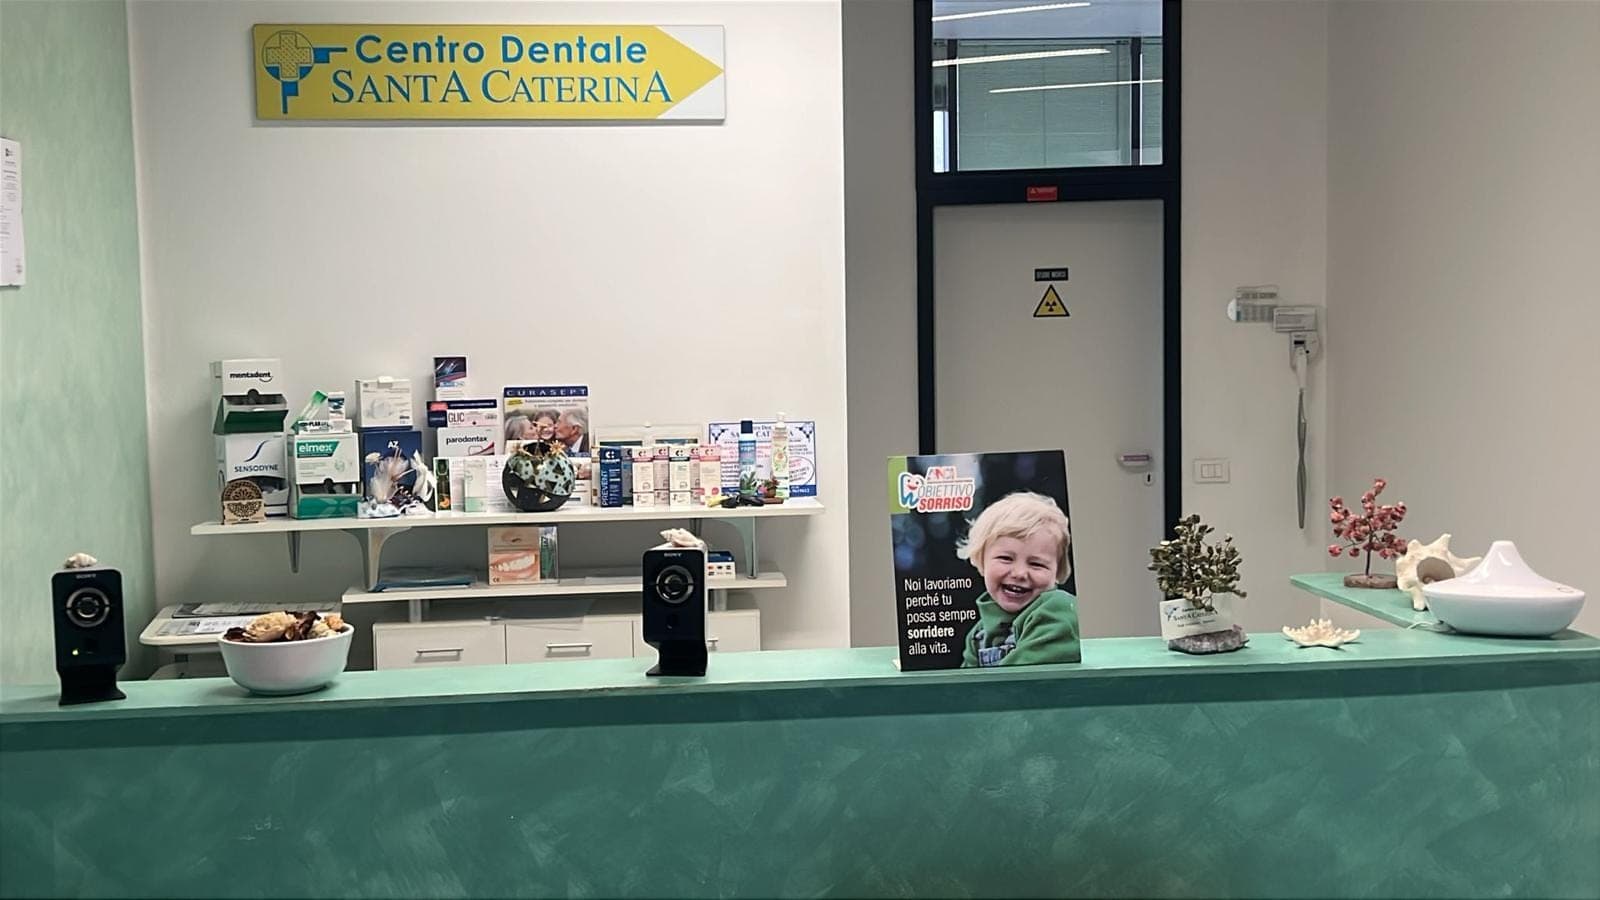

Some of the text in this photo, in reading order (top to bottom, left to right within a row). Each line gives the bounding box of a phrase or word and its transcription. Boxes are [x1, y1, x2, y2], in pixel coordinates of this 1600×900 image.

[355, 35, 648, 64] Centro Dentale
[331, 69, 674, 104] SANTA CATERINA
[506, 388, 586, 396] CURASEPT
[387, 440, 399, 449] AZ
[446, 435, 488, 445] parodontax
[298, 443, 333, 453] elmex
[234, 464, 279, 473] SENSODYNE
[601, 469, 609, 506] PREVENT
[918, 483, 974, 498] OBIETTIVO
[919, 496, 972, 511] SORRISO
[904, 577, 972, 591] Noi lavoriamo
[905, 592, 953, 610] perché tu
[906, 609, 976, 625] possa sempre
[907, 625, 955, 639] sorridere
[908, 641, 951, 655] alla vita.
